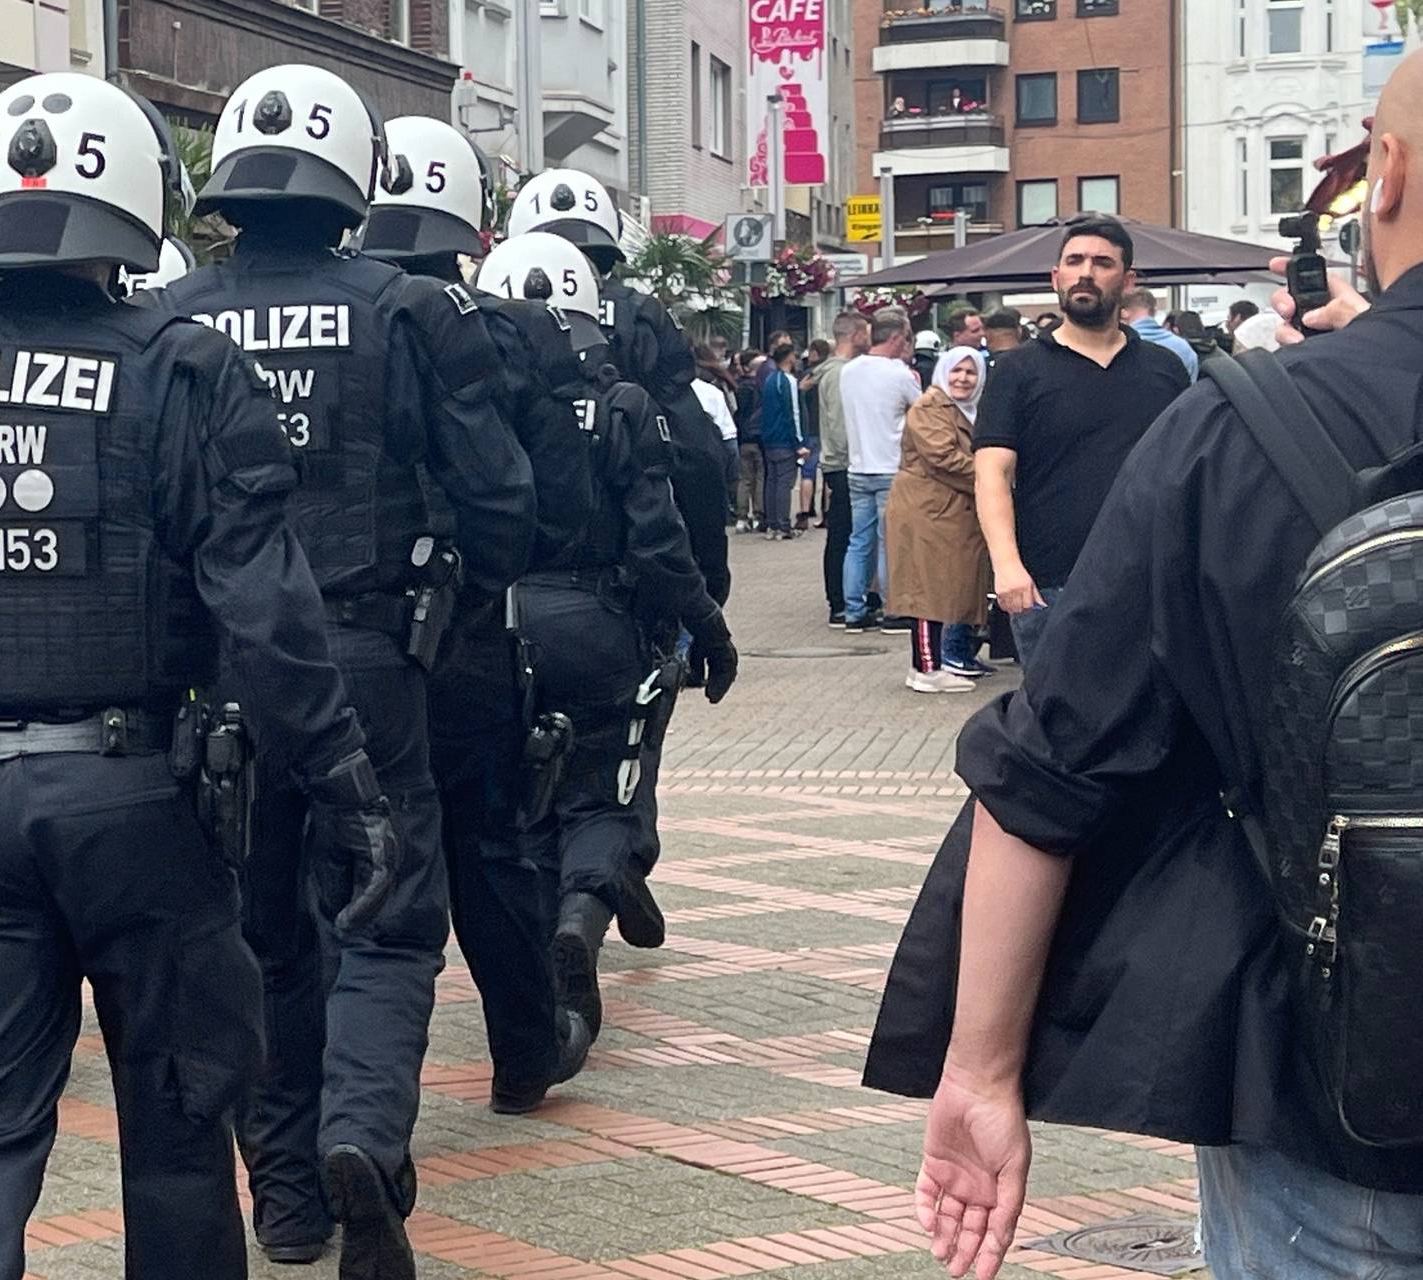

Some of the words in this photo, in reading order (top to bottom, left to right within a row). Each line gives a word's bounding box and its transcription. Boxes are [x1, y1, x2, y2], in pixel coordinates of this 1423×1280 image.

[233, 98, 248, 134] 1
[305, 103, 332, 140] 5
[75, 132, 106, 179] 5
[424, 160, 446, 194] 5
[529, 192, 541, 215] 1
[584, 190, 599, 212] 5
[500, 275, 513, 300] 1
[562, 269, 578, 297] 5
